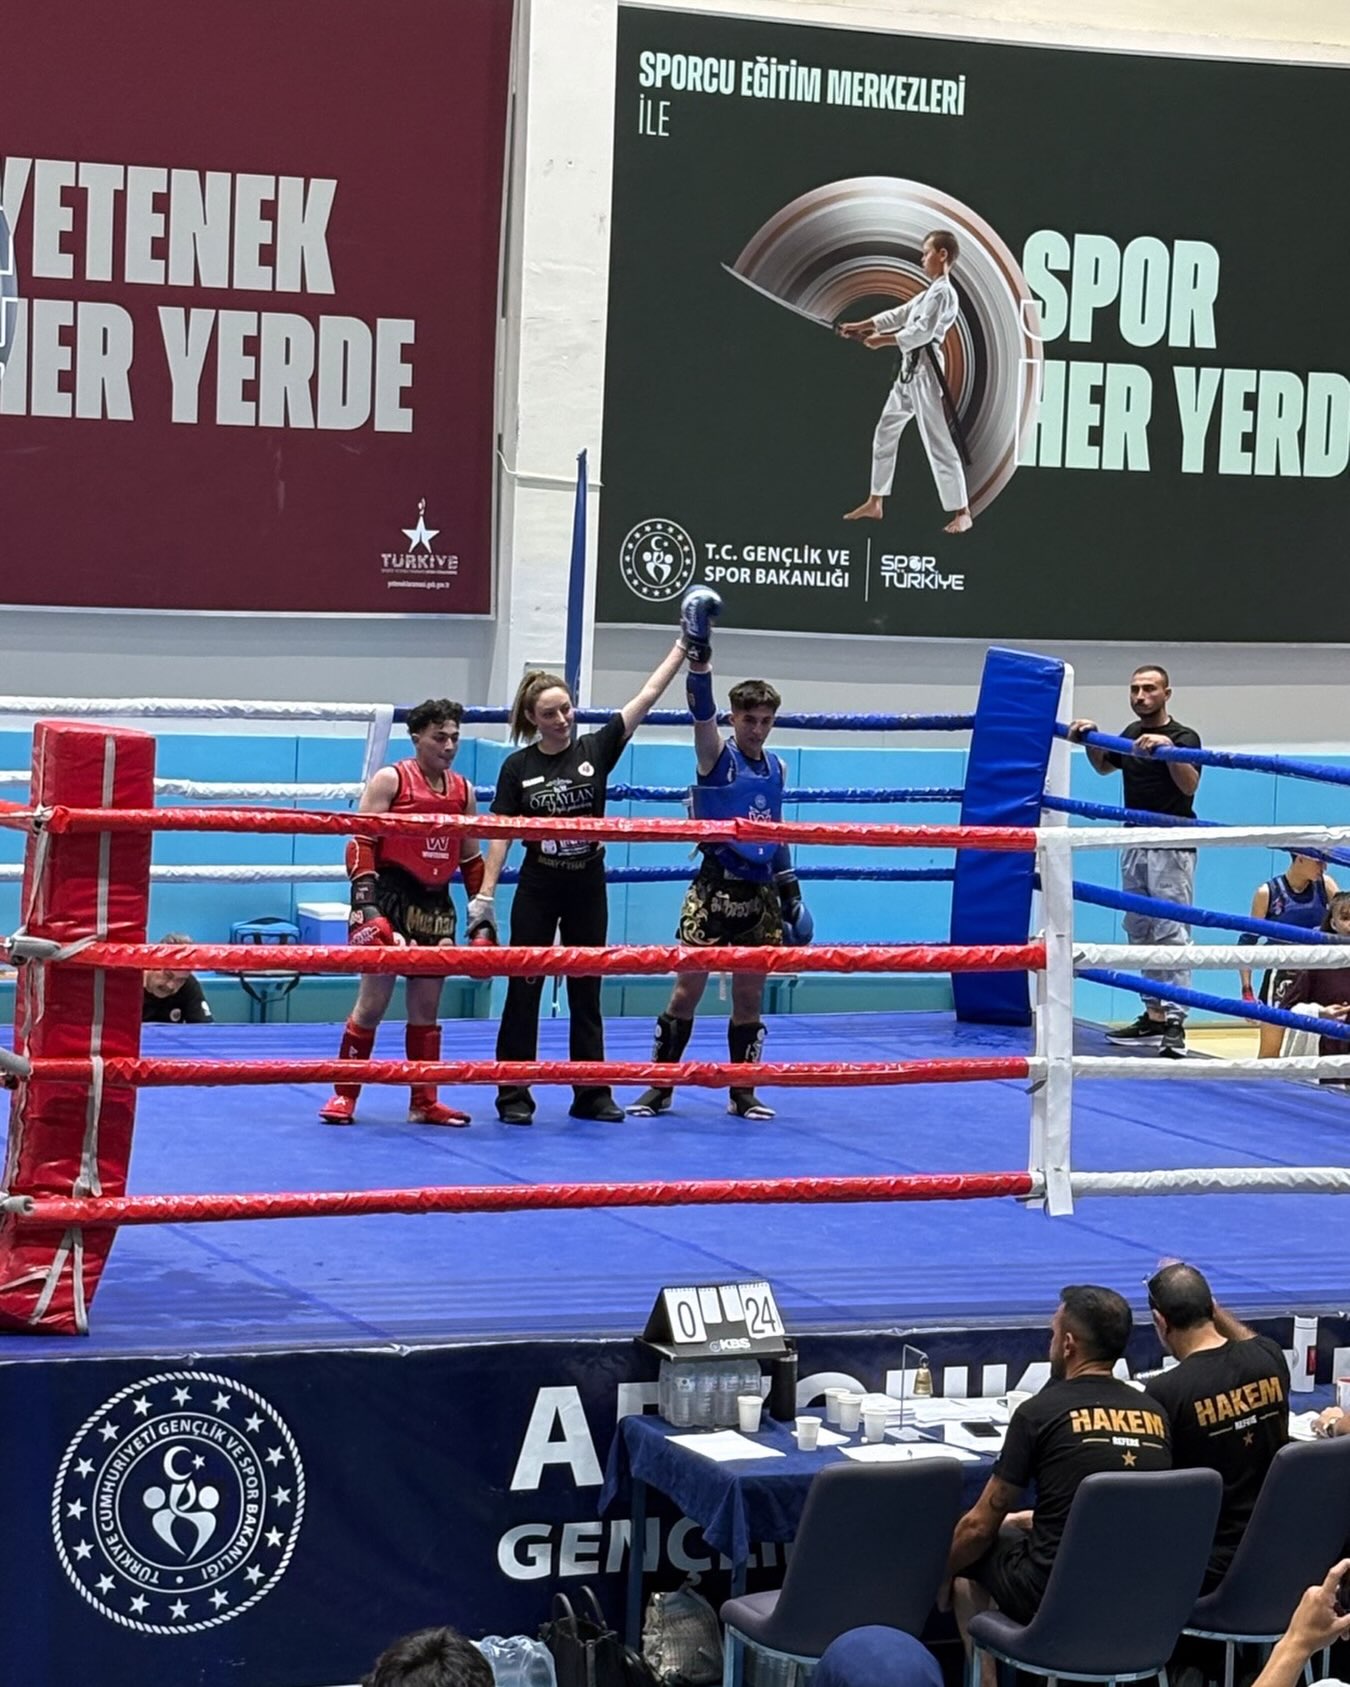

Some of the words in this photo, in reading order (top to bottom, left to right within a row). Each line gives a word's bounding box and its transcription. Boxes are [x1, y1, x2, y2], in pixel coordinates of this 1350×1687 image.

[639, 50, 736, 95] SPORCU
[740, 56, 822, 103] EĞİTİM
[826, 69, 966, 116] MERKEZLERİ
[638, 93, 671, 136] İLE
[1020, 229, 1220, 349] SPOR
[157, 306, 416, 433] YERDE
[1014, 358, 1152, 471] HER
[1173, 366, 1350, 478] YERD
[705, 543, 738, 561] T.C.
[743, 544, 821, 566] GENÇLİK
[827, 549, 850, 566] VE
[881, 555, 936, 572] SPOR
[704, 566, 751, 584] SPOR
[755, 567, 849, 588] BAKANLIĞI
[880, 569, 965, 590] TÜRKİYE
[677, 1301, 697, 1338] 0
[745, 1296, 776, 1335] 24
[720, 1338, 751, 1351] KBS
[1194, 1376, 1283, 1426] HAKEM
[158, 1419, 227, 1442] GENÇLİK
[1069, 1407, 1166, 1439] HAKEM
[225, 1436, 244, 1456] VE
[100, 1424, 157, 1532] CUMHURİYETİ
[238, 1456, 259, 1500] SPOR
[105, 1532, 160, 1584] TÜRKİYE
[200, 1503, 258, 1580] BAKANLIĞI
